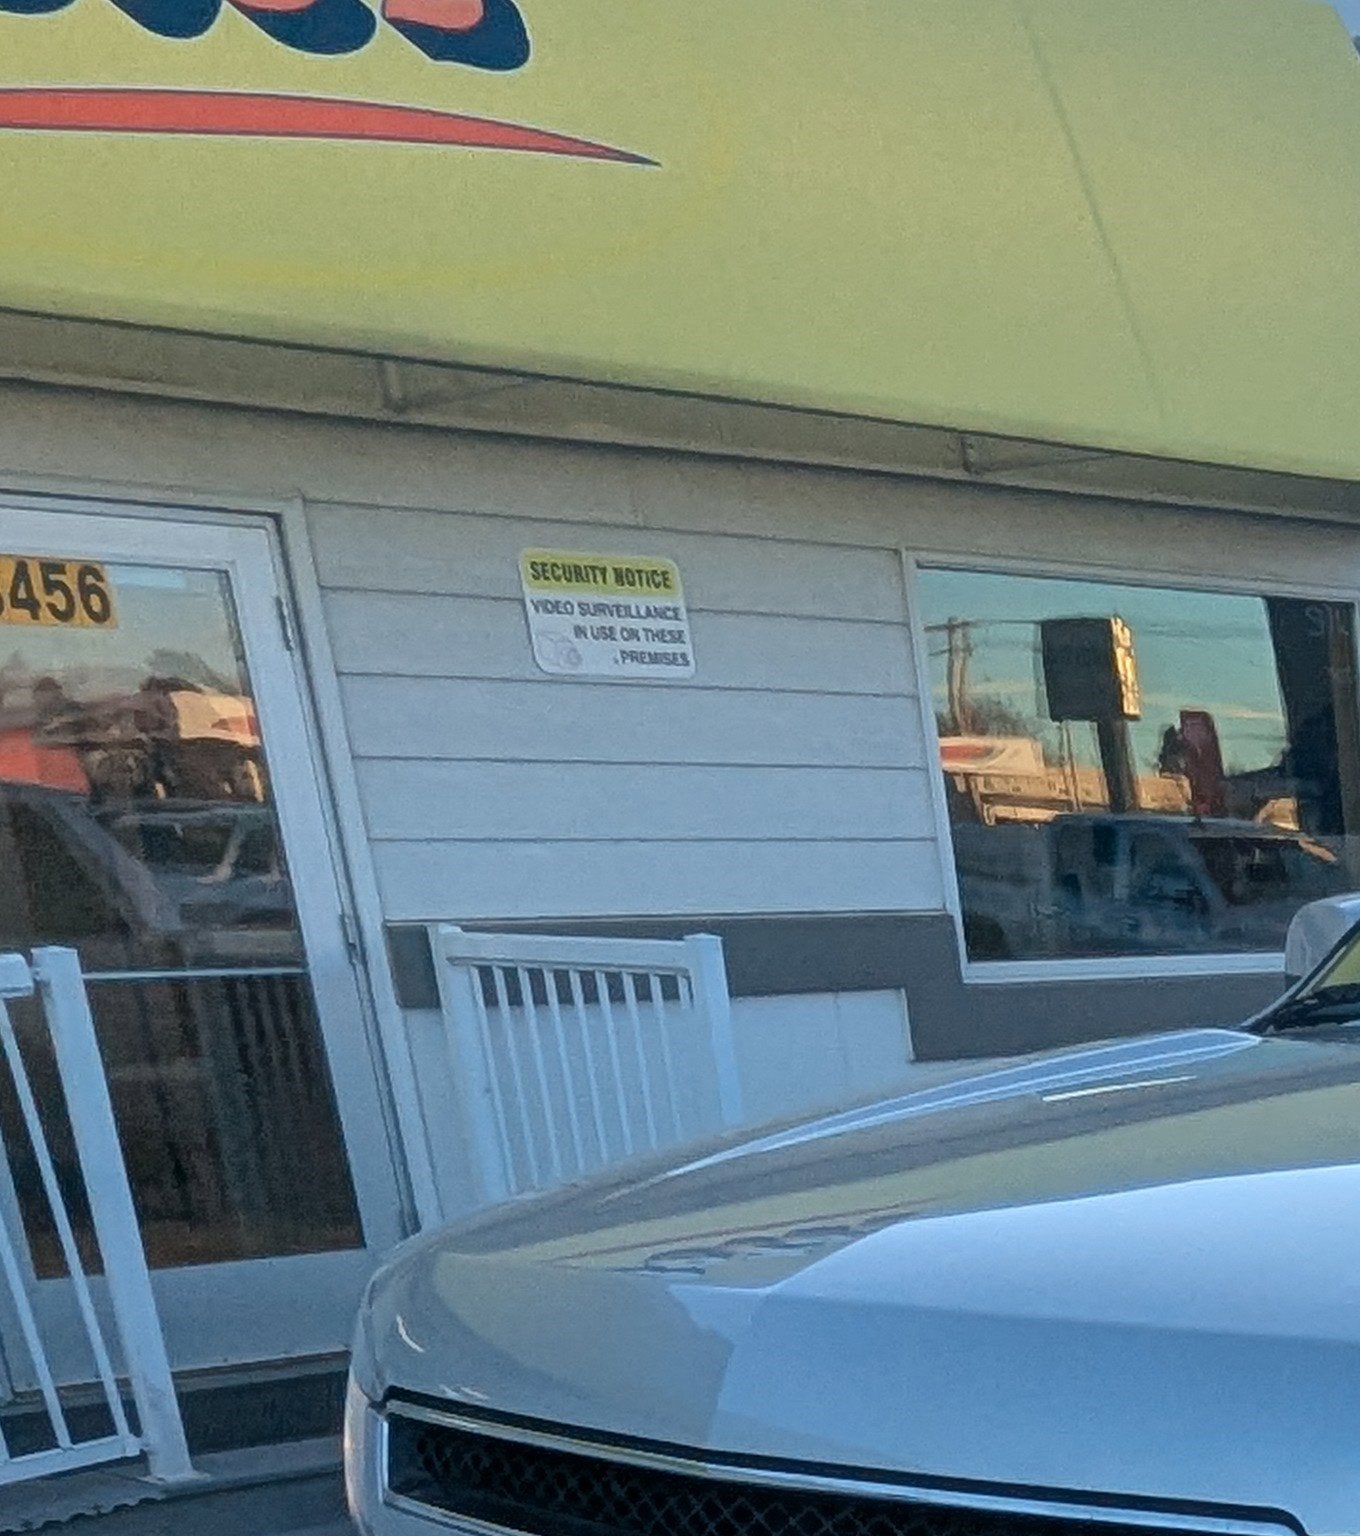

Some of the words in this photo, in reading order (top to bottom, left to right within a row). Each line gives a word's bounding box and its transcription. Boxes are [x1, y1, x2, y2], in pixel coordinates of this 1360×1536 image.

[530, 561, 608, 585] SECURITY
[612, 566, 673, 589] NOTICE
[0, 560, 112, 624] 456
[530, 599, 574, 616] VIDEO
[577, 602, 683, 621] SURVEILLANCE
[573, 625, 588, 640] IN
[590, 626, 617, 641] USE
[620, 628, 640, 642] ON
[643, 629, 687, 644] THESE
[619, 650, 691, 667] PREMISES
